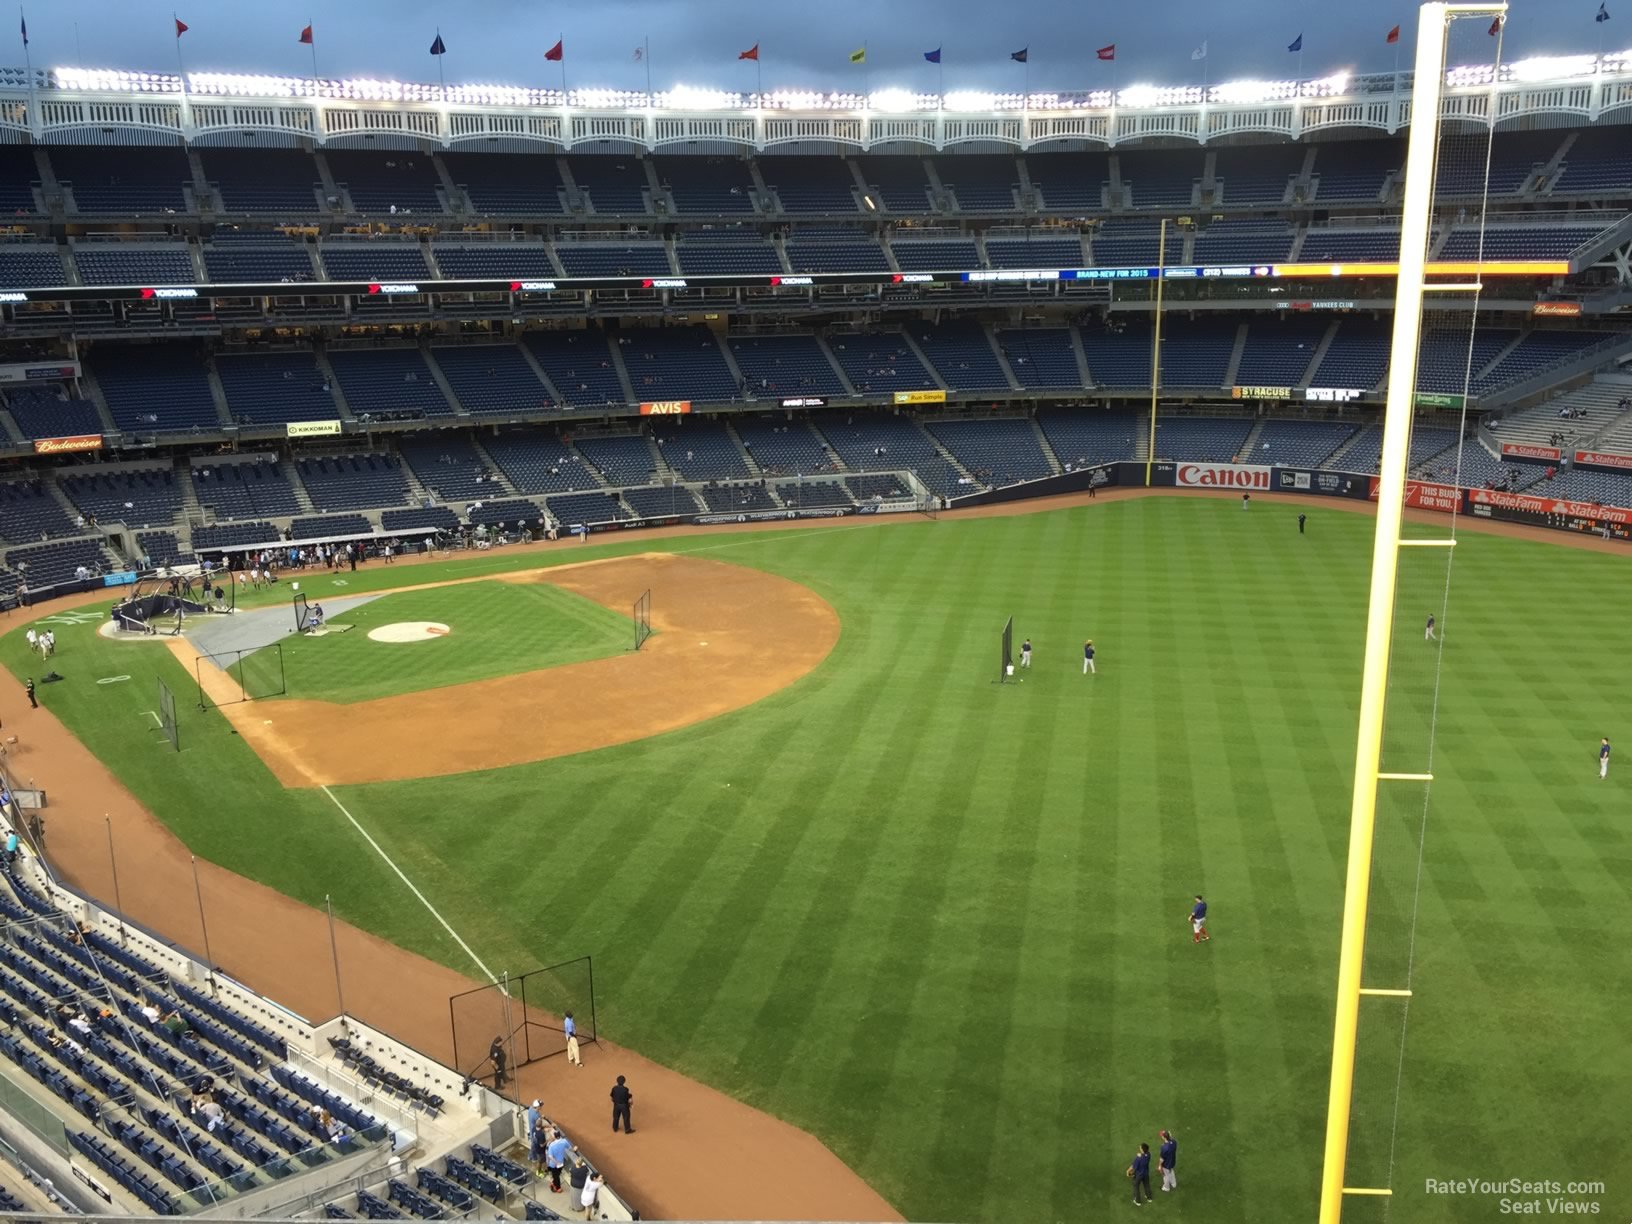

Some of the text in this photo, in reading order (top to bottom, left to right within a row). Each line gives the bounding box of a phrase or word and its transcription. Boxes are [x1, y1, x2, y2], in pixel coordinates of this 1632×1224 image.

[1076, 269, 1149, 278] BRAND-NEW FOR 2015
[1534, 304, 1580, 314] Budweiser
[1242, 387, 1291, 396] SYRACUSE
[650, 402, 682, 414] AVIS
[35, 440, 101, 453] Budweiser
[1178, 465, 1269, 488] Canon
[1420, 486, 1462, 500] THIS BUDS
[1420, 496, 1453, 509] FOR YOU.
[1568, 504, 1597, 518] State
